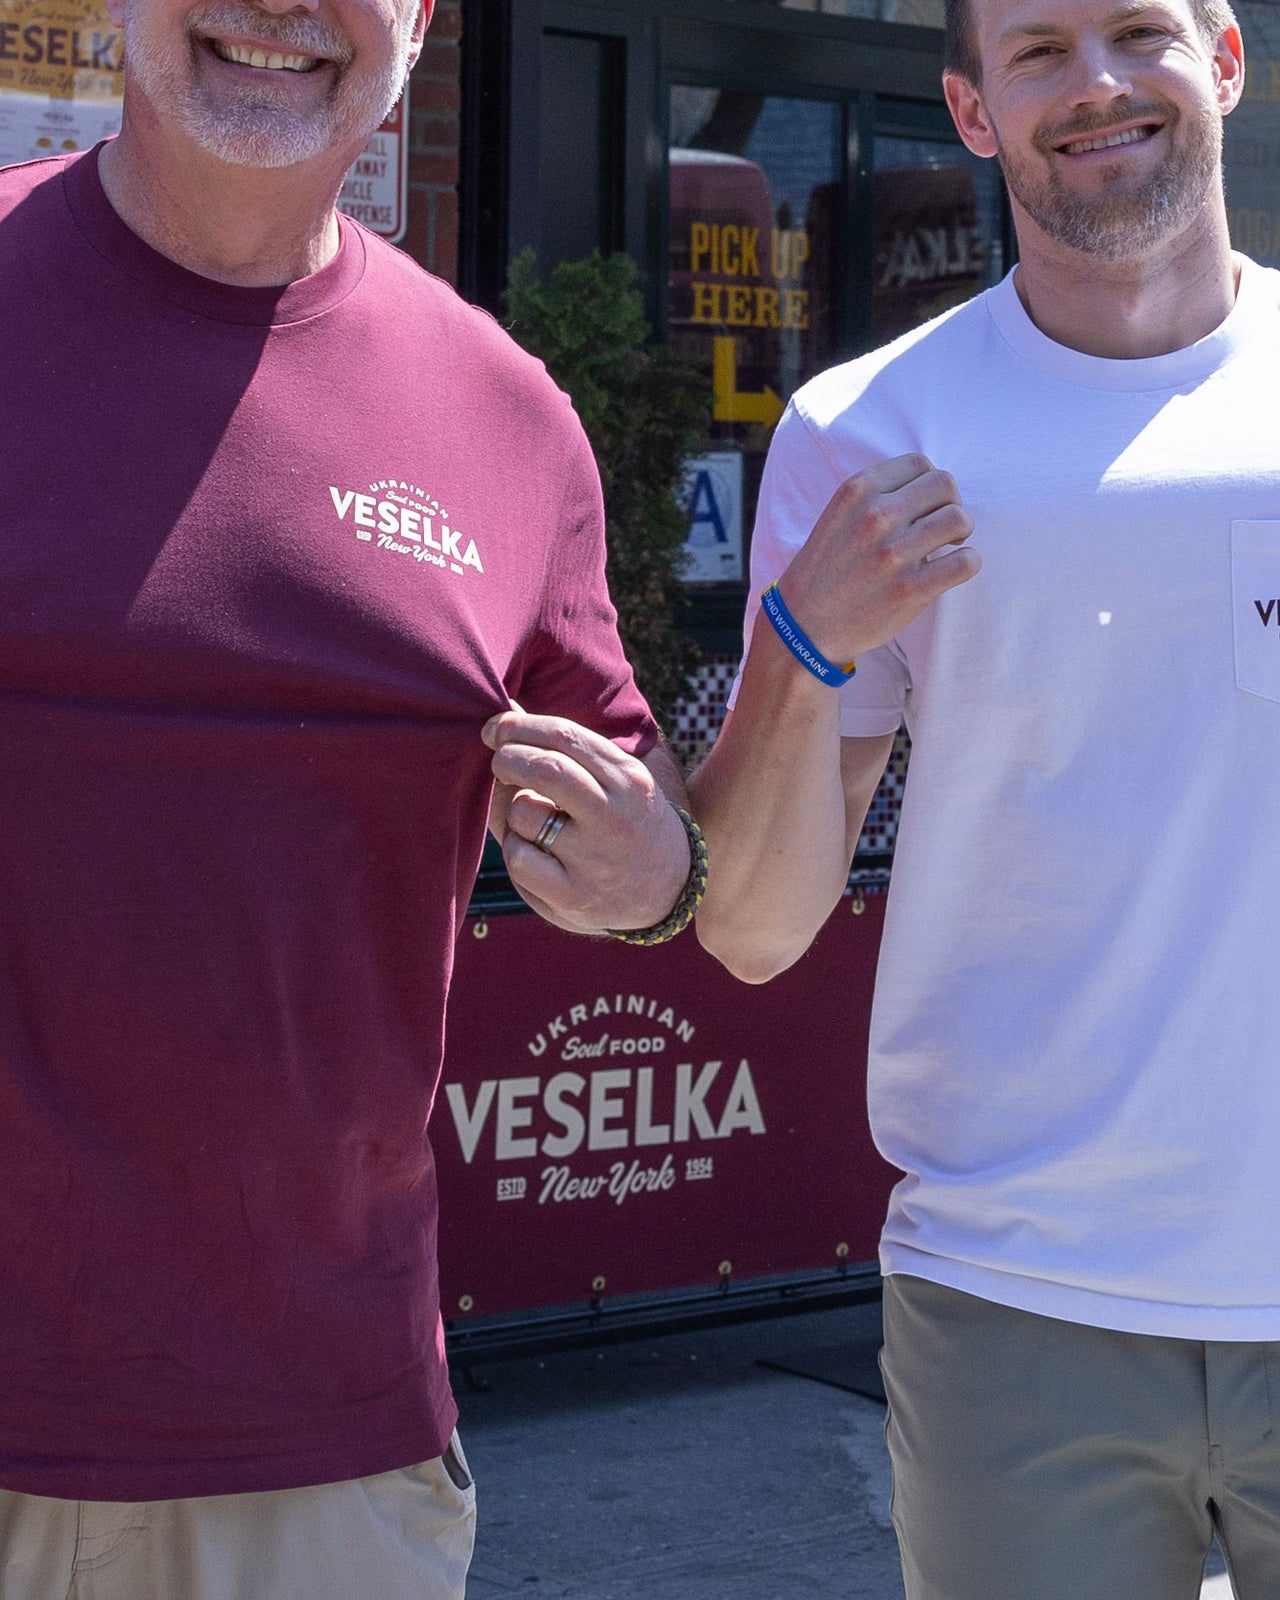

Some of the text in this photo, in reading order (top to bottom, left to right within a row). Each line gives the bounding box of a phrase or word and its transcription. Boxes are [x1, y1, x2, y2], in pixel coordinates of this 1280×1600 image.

[354, 159, 388, 179] AWAY
[691, 221, 810, 280] PICK UP
[690, 281, 810, 331] HERE
[369, 479, 449, 520] UKRAINIAN
[682, 469, 729, 544] A
[328, 485, 485, 574] VESELKA
[376, 532, 413, 555] New
[411, 545, 447, 568] York
[775, 613, 796, 641] WITH
[791, 638, 830, 677] UKRAINE
[528, 994, 696, 1057] UKRAINIAN
[561, 1033, 666, 1061] Soul FOOD
[445, 1058, 767, 1164] VESELKA
[496, 1153, 713, 1205] ESTD New York 1954
